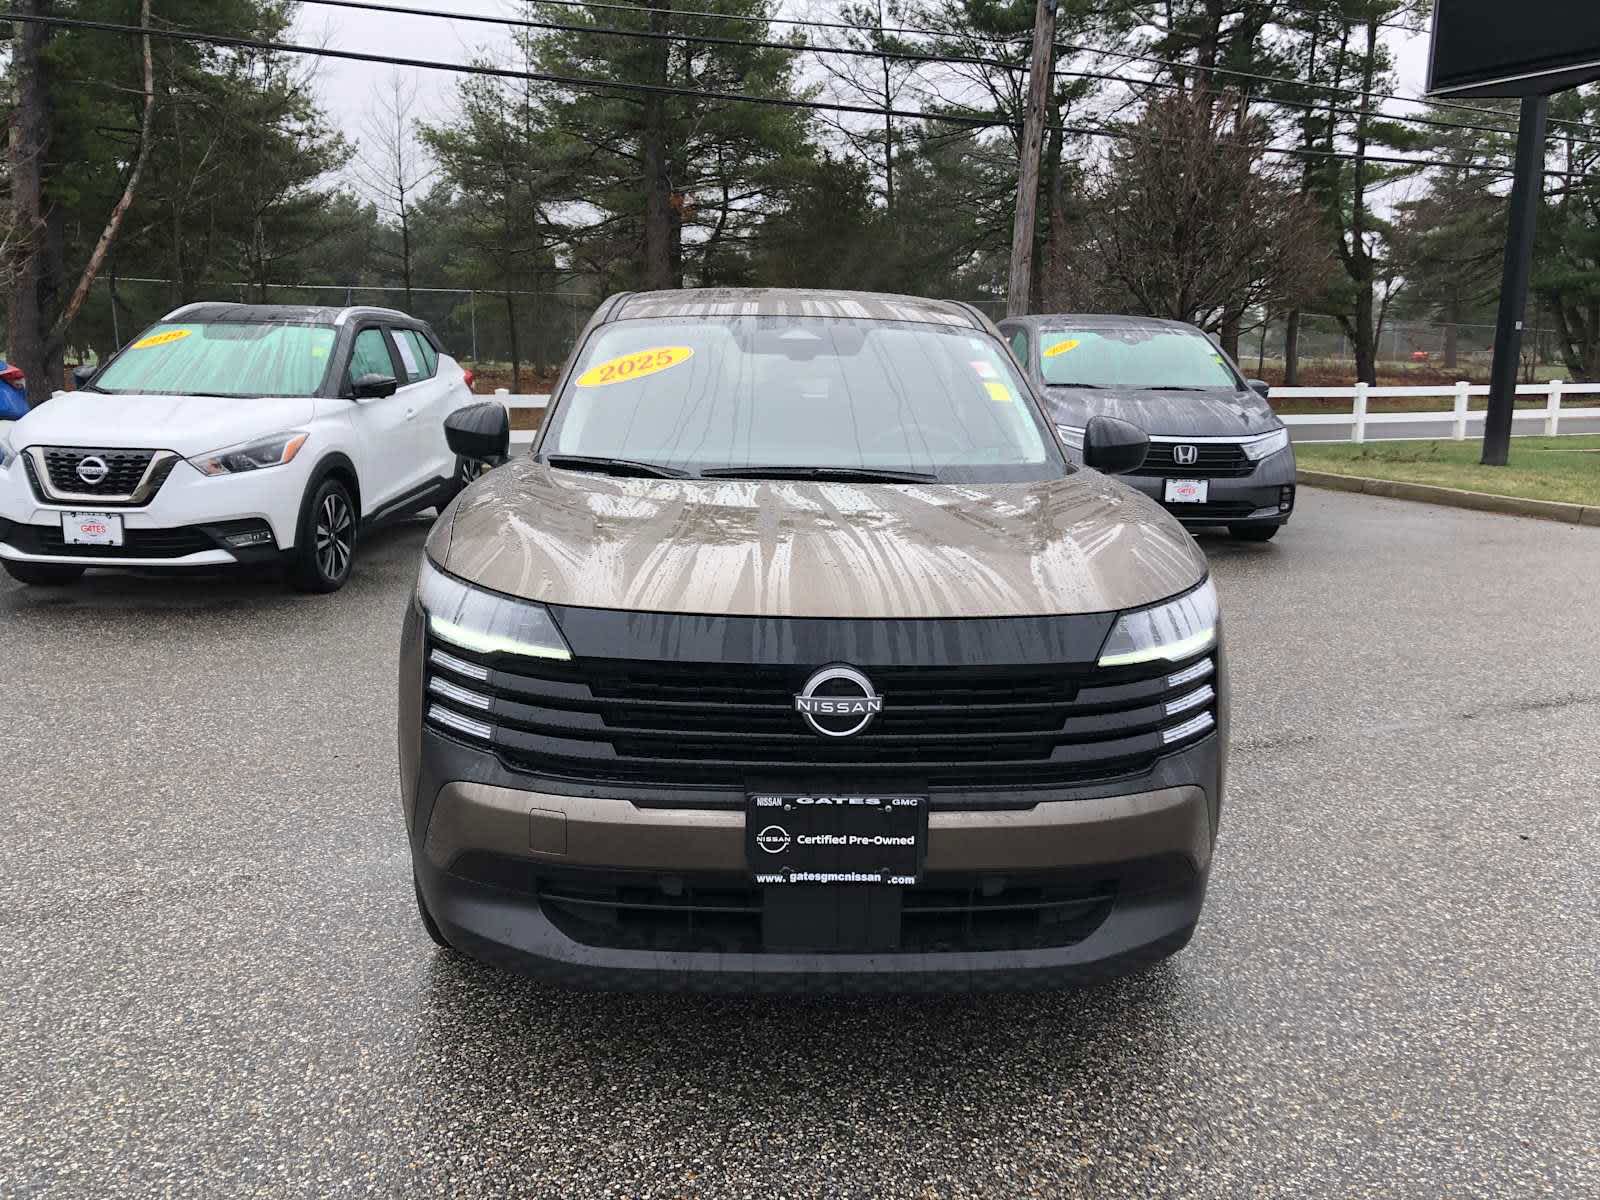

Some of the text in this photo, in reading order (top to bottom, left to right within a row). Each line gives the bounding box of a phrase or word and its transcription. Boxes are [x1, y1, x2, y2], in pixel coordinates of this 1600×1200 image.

[599, 350, 673, 382] 2025
[80, 524, 106, 533] GATES
[797, 699, 881, 713] NISSAN
[756, 797, 918, 807] NISSAN GATES GMC
[797, 834, 915, 845] Certified Pre-Owned
[756, 871, 915, 885] www. gatesgmcnissan .com
